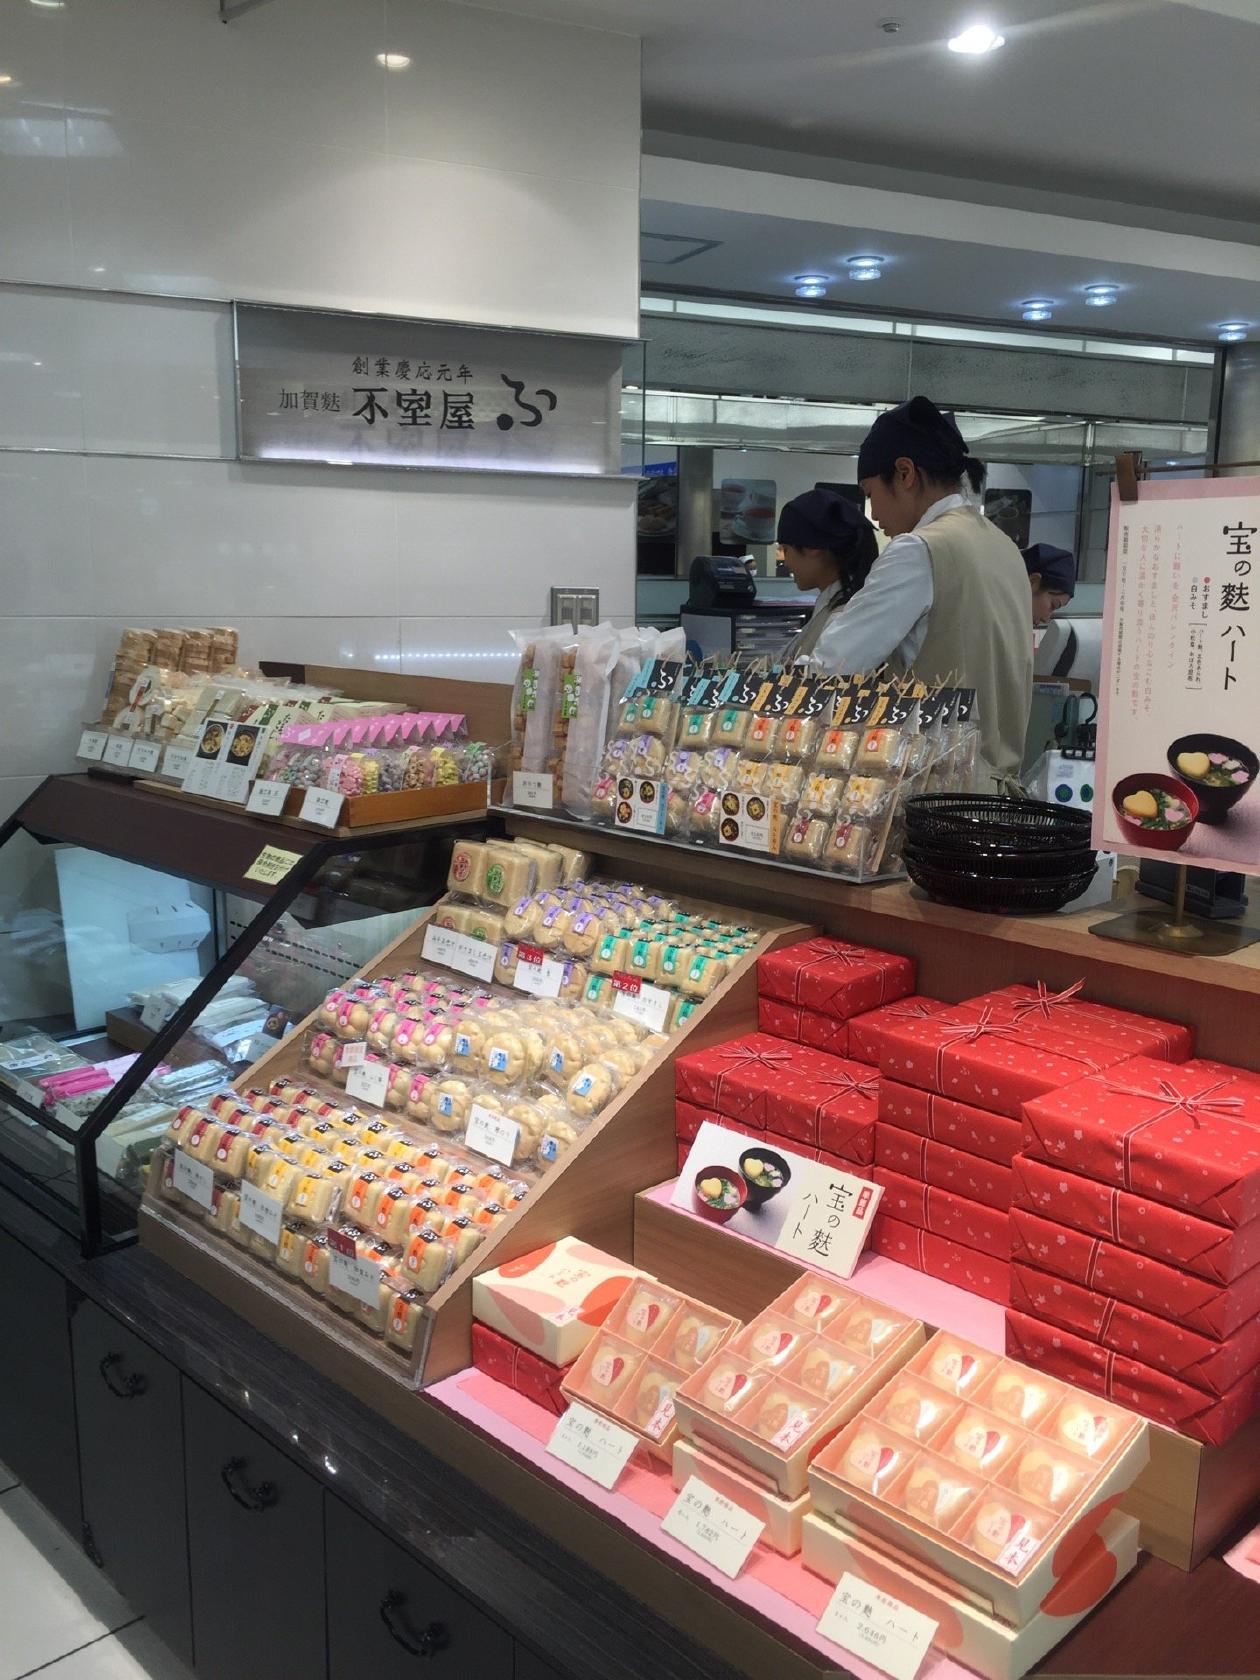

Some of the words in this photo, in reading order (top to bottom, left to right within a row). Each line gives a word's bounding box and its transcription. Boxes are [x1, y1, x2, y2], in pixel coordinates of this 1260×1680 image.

[352, 356, 474, 385] 創業慶応元年
[279, 388, 341, 413] 加賀麩
[352, 387, 476, 430] 不室屋
[1219, 521, 1258, 612] 宝の麩
[1189, 584, 1198, 611] 白みそ
[1201, 584, 1210, 619] おすまし
[1220, 624, 1247, 691] ハート
[612, 977, 639, 993] 第2位
[793, 1193, 818, 1239] ハート
[808, 1184, 853, 1257] 宝の麩
[564, 1416, 593, 1439] 宝の麩
[652, 1402, 674, 1434] 見本
[684, 1492, 713, 1519] 宝の麩
[719, 1517, 749, 1542] ハート
[1006, 1537, 1031, 1566] 見本
[839, 1591, 875, 1619] 宝の麩
[886, 1617, 920, 1643] ハート
